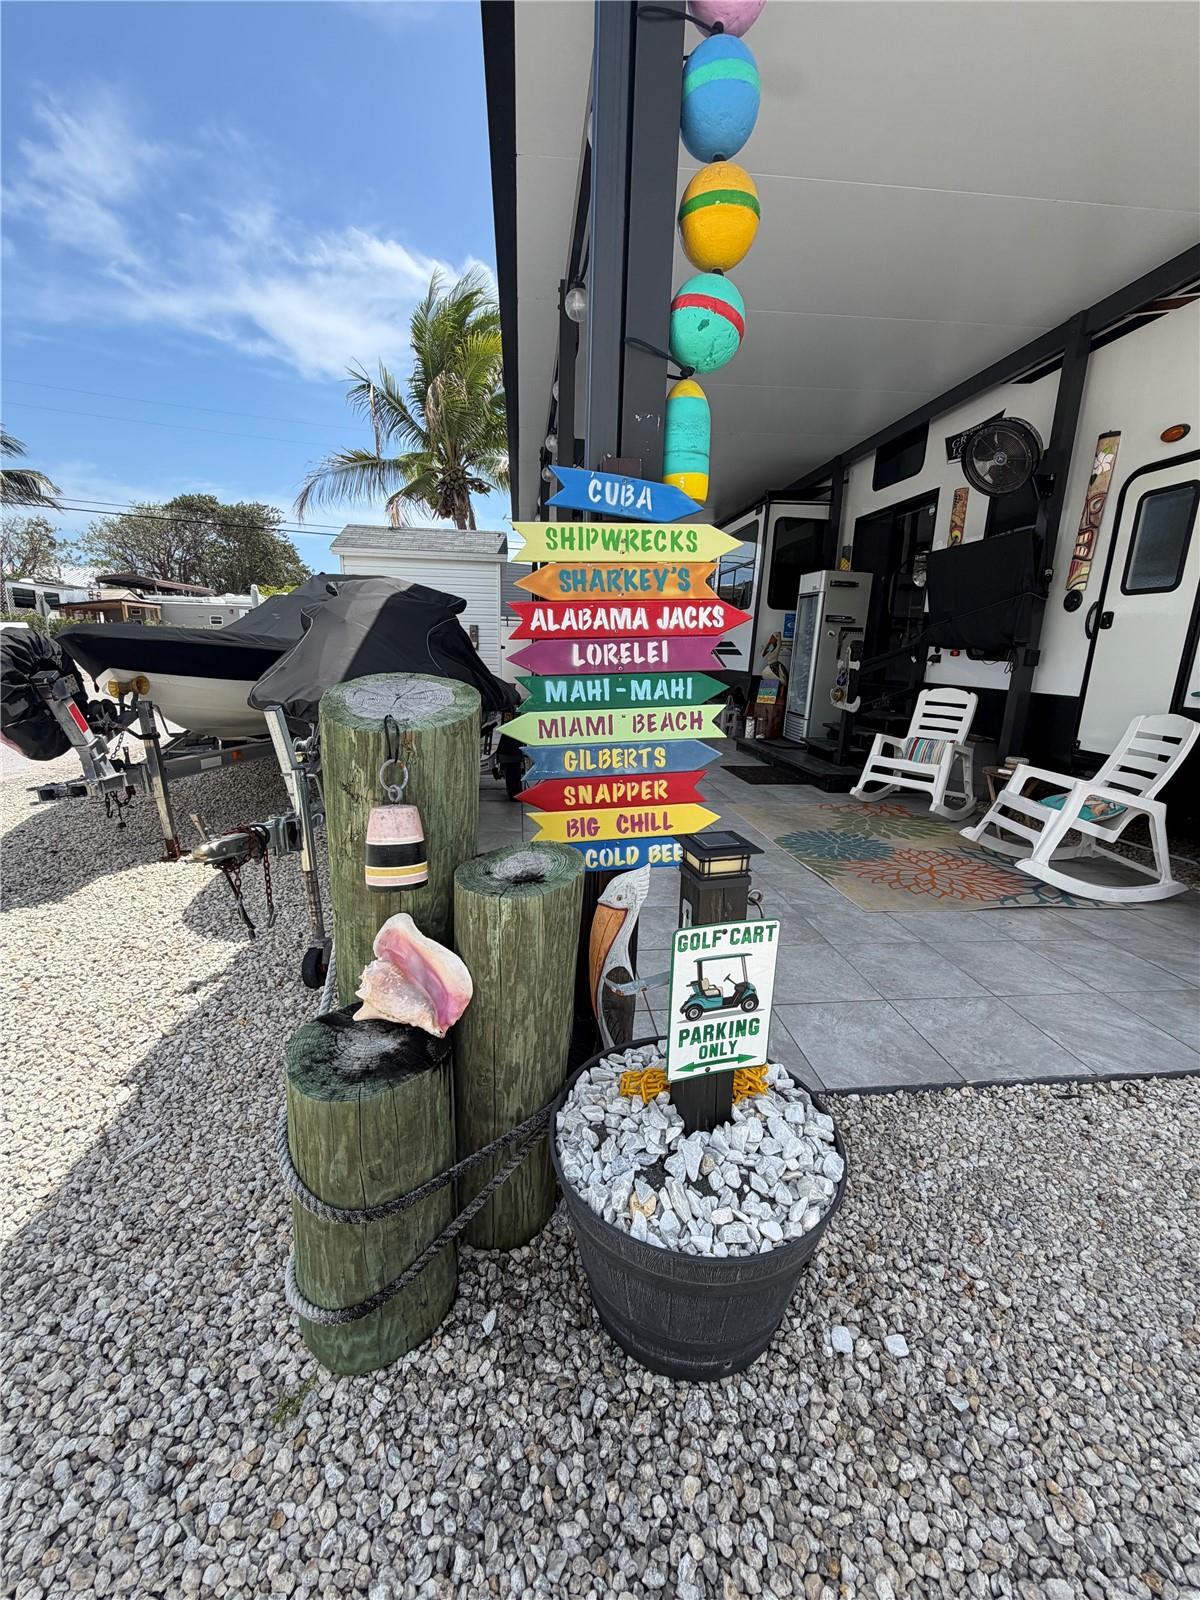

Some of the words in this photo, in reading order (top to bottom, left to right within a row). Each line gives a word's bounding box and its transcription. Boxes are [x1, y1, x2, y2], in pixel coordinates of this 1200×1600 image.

[588, 479, 653, 511] CUBA
[545, 526, 698, 553] SHIPWRECKS
[558, 567, 691, 592] SHARKEY'S
[530, 607, 649, 631] ALABAMA
[656, 605, 725, 629] JACKS
[572, 640, 669, 666] LORELEI
[537, 714, 613, 739] MIAMI
[632, 711, 703, 733] BEACH
[563, 747, 667, 771] GILBERTS
[563, 780, 669, 806] SNAPPER
[566, 817, 600, 838] BIG
[616, 811, 674, 834] CHILL
[585, 845, 640, 869] COLD
[648, 842, 684, 864] BEE
[677, 929, 722, 953] GOLF
[729, 924, 777, 945] CART
[678, 1018, 760, 1048] PARKING
[698, 1039, 738, 1060] ONLY
